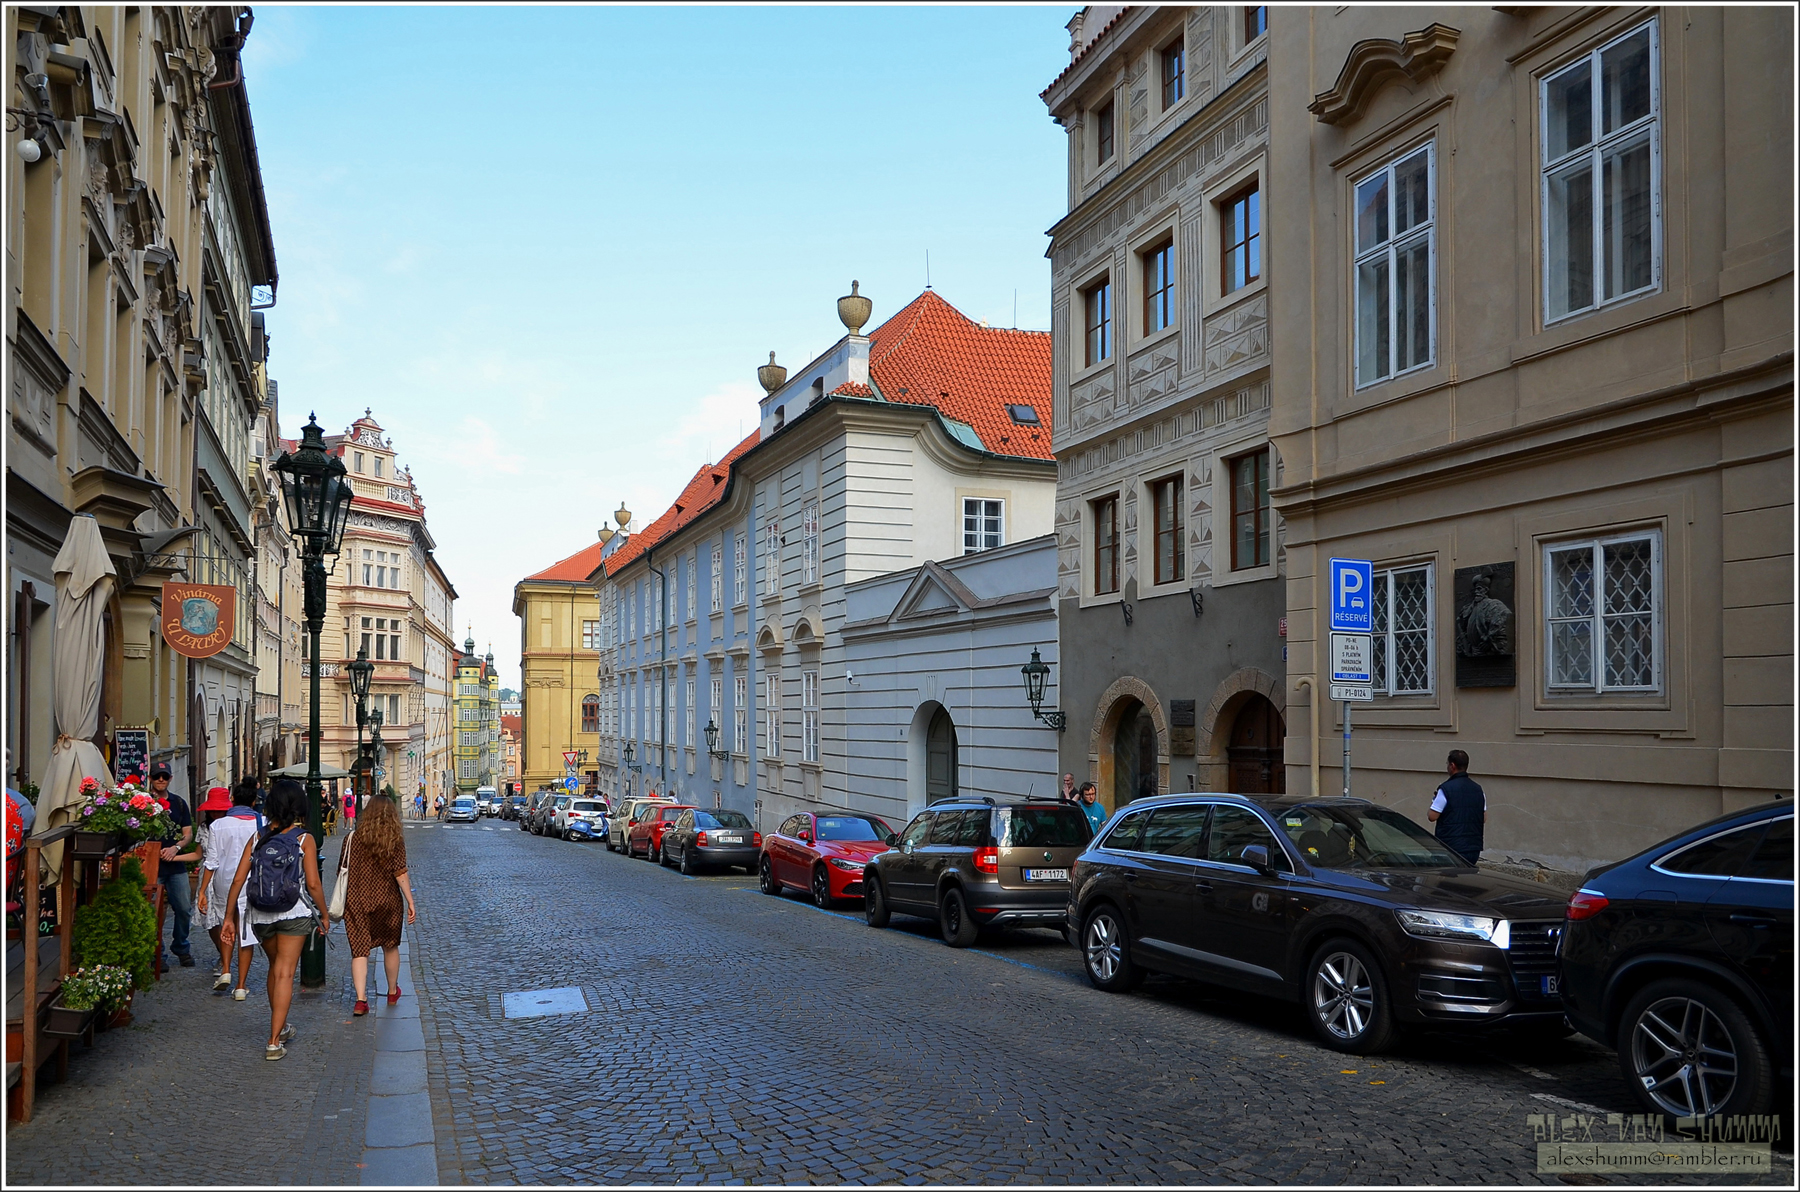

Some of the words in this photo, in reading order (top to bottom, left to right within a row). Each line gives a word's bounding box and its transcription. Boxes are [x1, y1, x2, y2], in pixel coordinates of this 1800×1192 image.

[1340, 568, 1363, 607] P
[170, 588, 223, 605] Vinárna
[1335, 611, 1368, 622] RÉSERVÉ
[1345, 689, 1366, 697] P1-0124
[1031, 870, 1043, 878] 4AF
[1048, 870, 1064, 878] 1172
